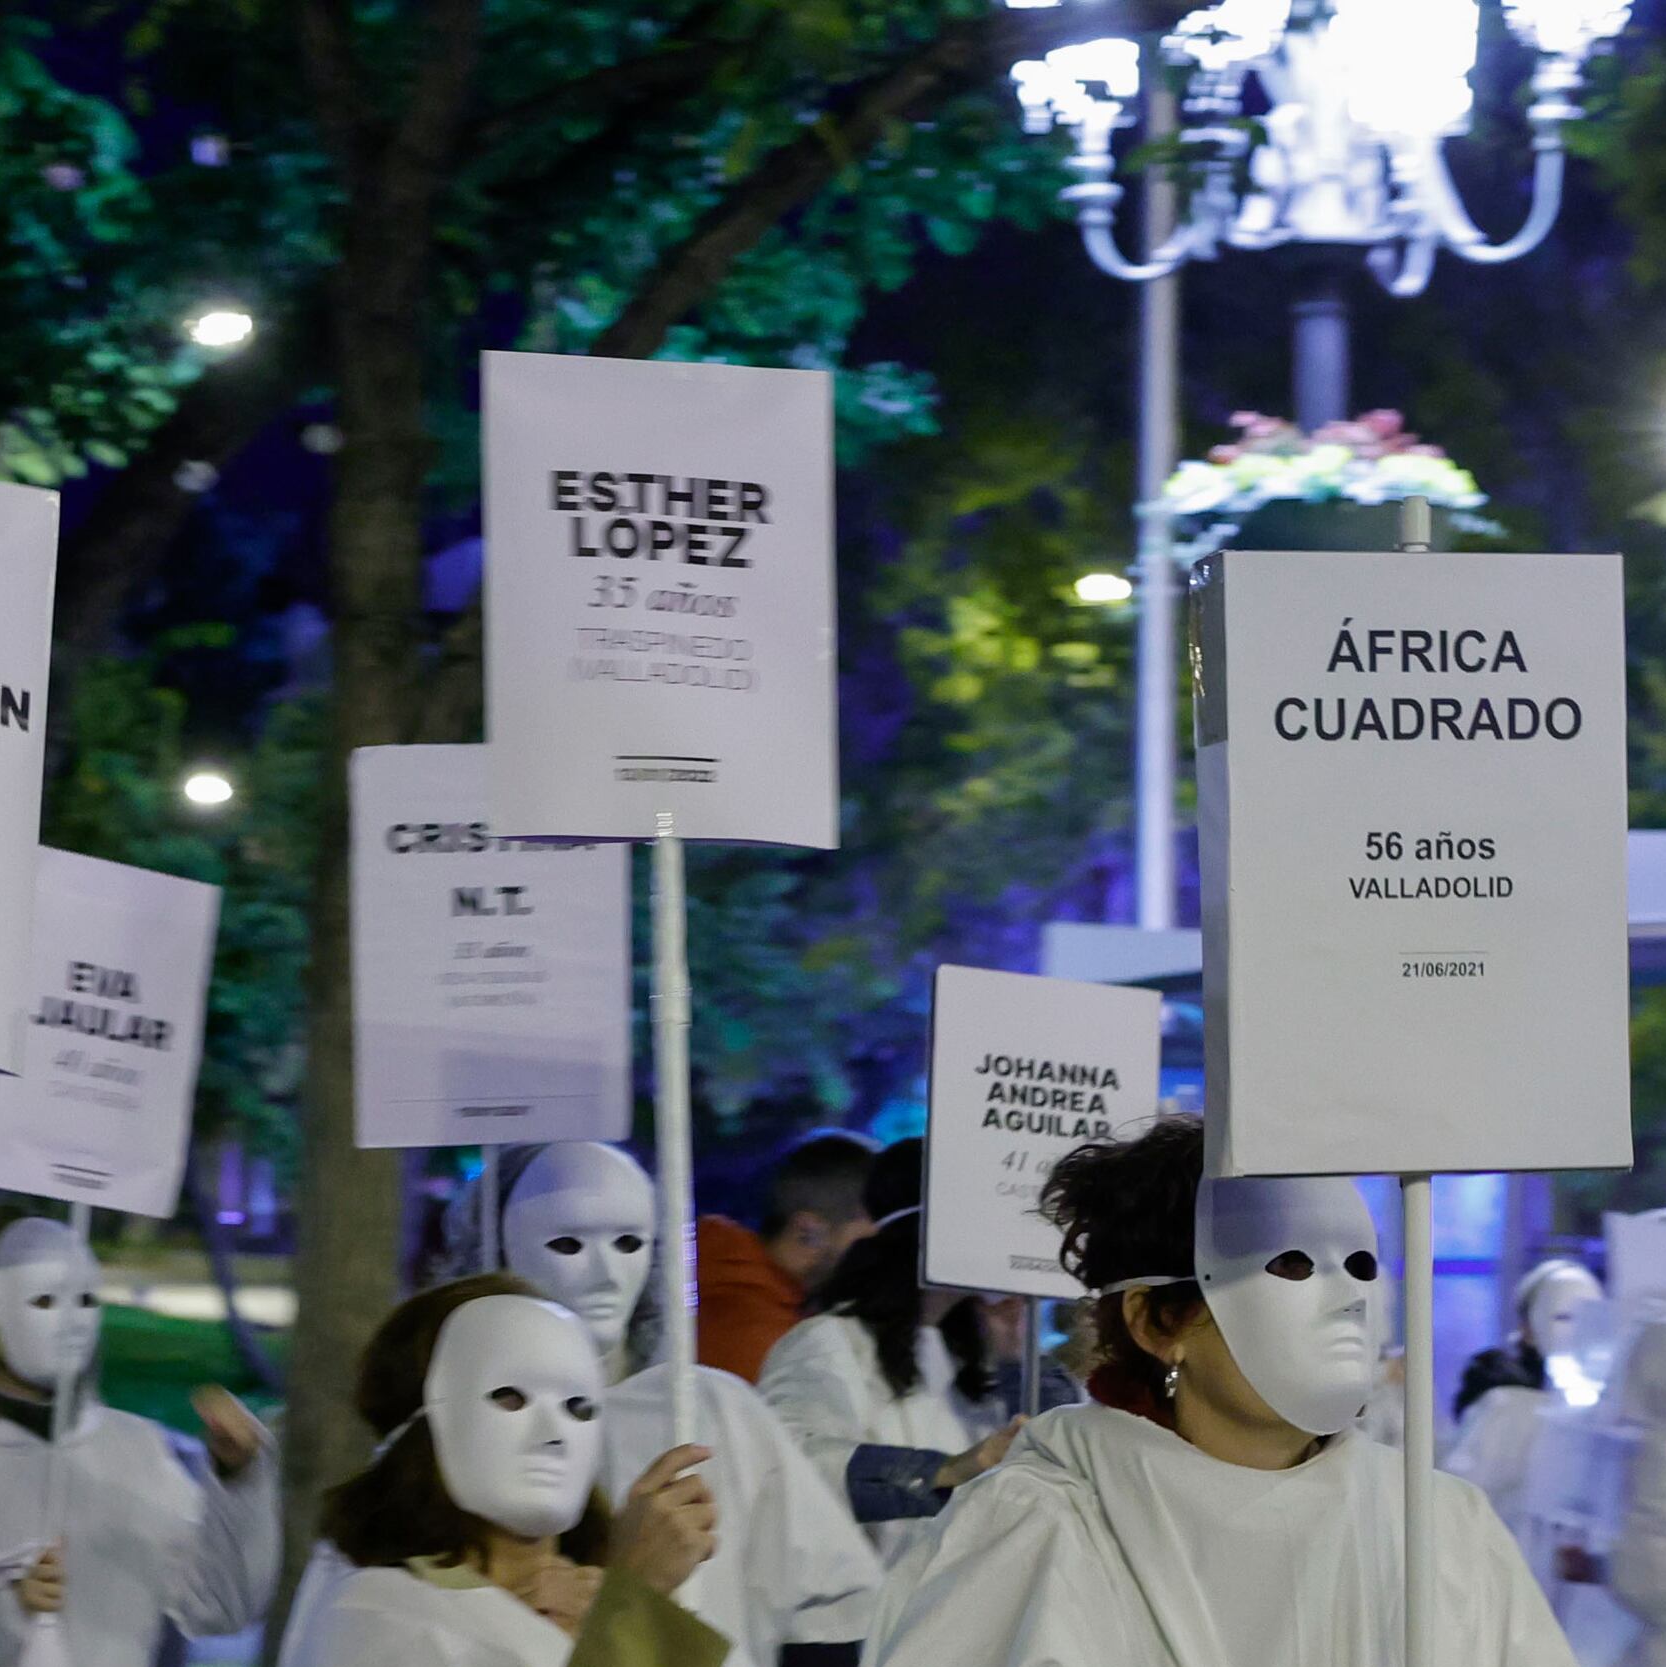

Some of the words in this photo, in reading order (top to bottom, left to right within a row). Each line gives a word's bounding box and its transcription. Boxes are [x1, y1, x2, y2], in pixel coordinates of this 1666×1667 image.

[549, 470, 773, 524] ESTHER
[644, 581, 739, 618] años
[1326, 618, 1528, 673] ÁFRICA
[1275, 697, 1582, 741] CUADRADO
[1365, 832, 1403, 860] 56
[1415, 832, 1496, 860] años
[1349, 877, 1513, 899] VALLADOLID
[66, 960, 139, 1003] EVA
[1402, 962, 1486, 977] 21/06/2021
[30, 996, 173, 1052] JAULAR
[974, 1054, 1120, 1090] JOHANNA
[987, 1082, 1108, 1115] ANDREA
